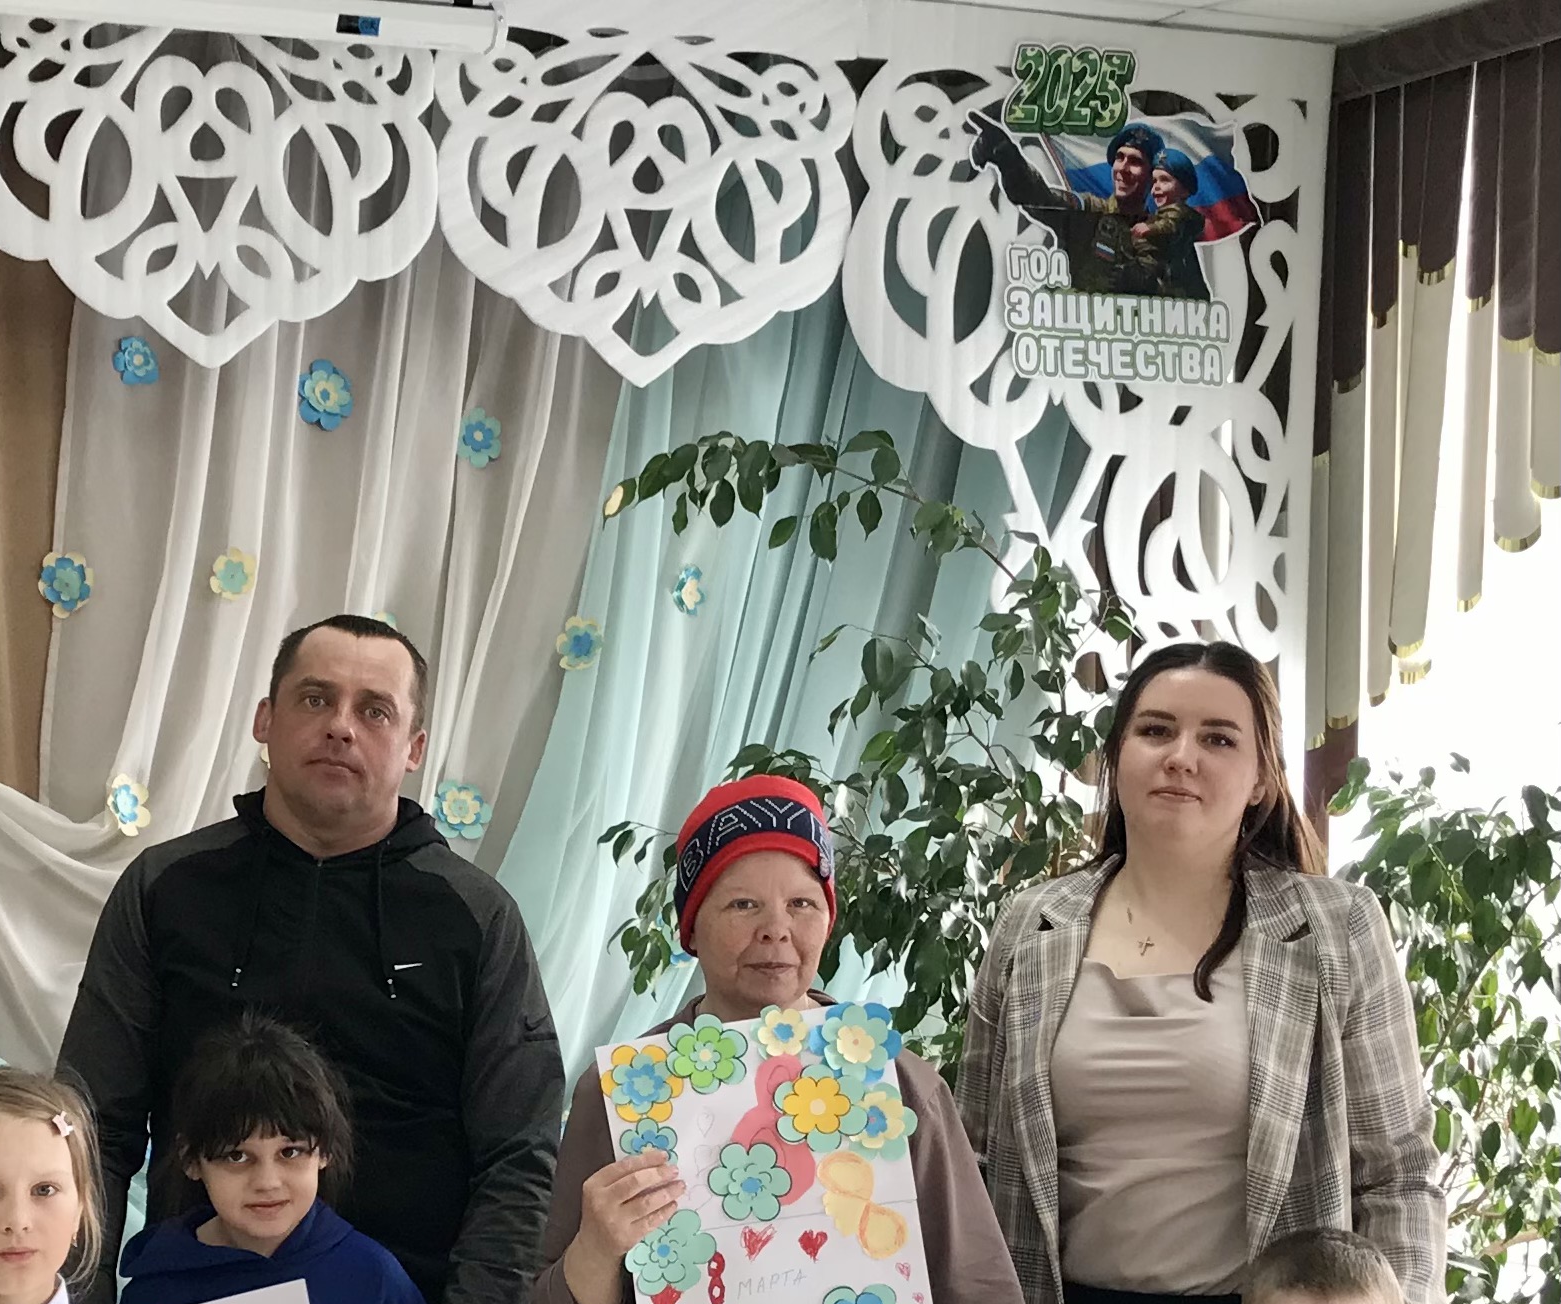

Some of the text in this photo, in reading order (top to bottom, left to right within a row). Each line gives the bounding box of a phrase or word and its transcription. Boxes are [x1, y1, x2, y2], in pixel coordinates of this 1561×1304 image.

[1005, 45, 1135, 136] 2025
[1009, 247, 1070, 288] ГОД
[1008, 288, 1229, 342] ЗАЩИТНИКА
[1015, 335, 1224, 385] ОТЕЧЕСТВА
[737, 1268, 807, 1299] МАРТА
